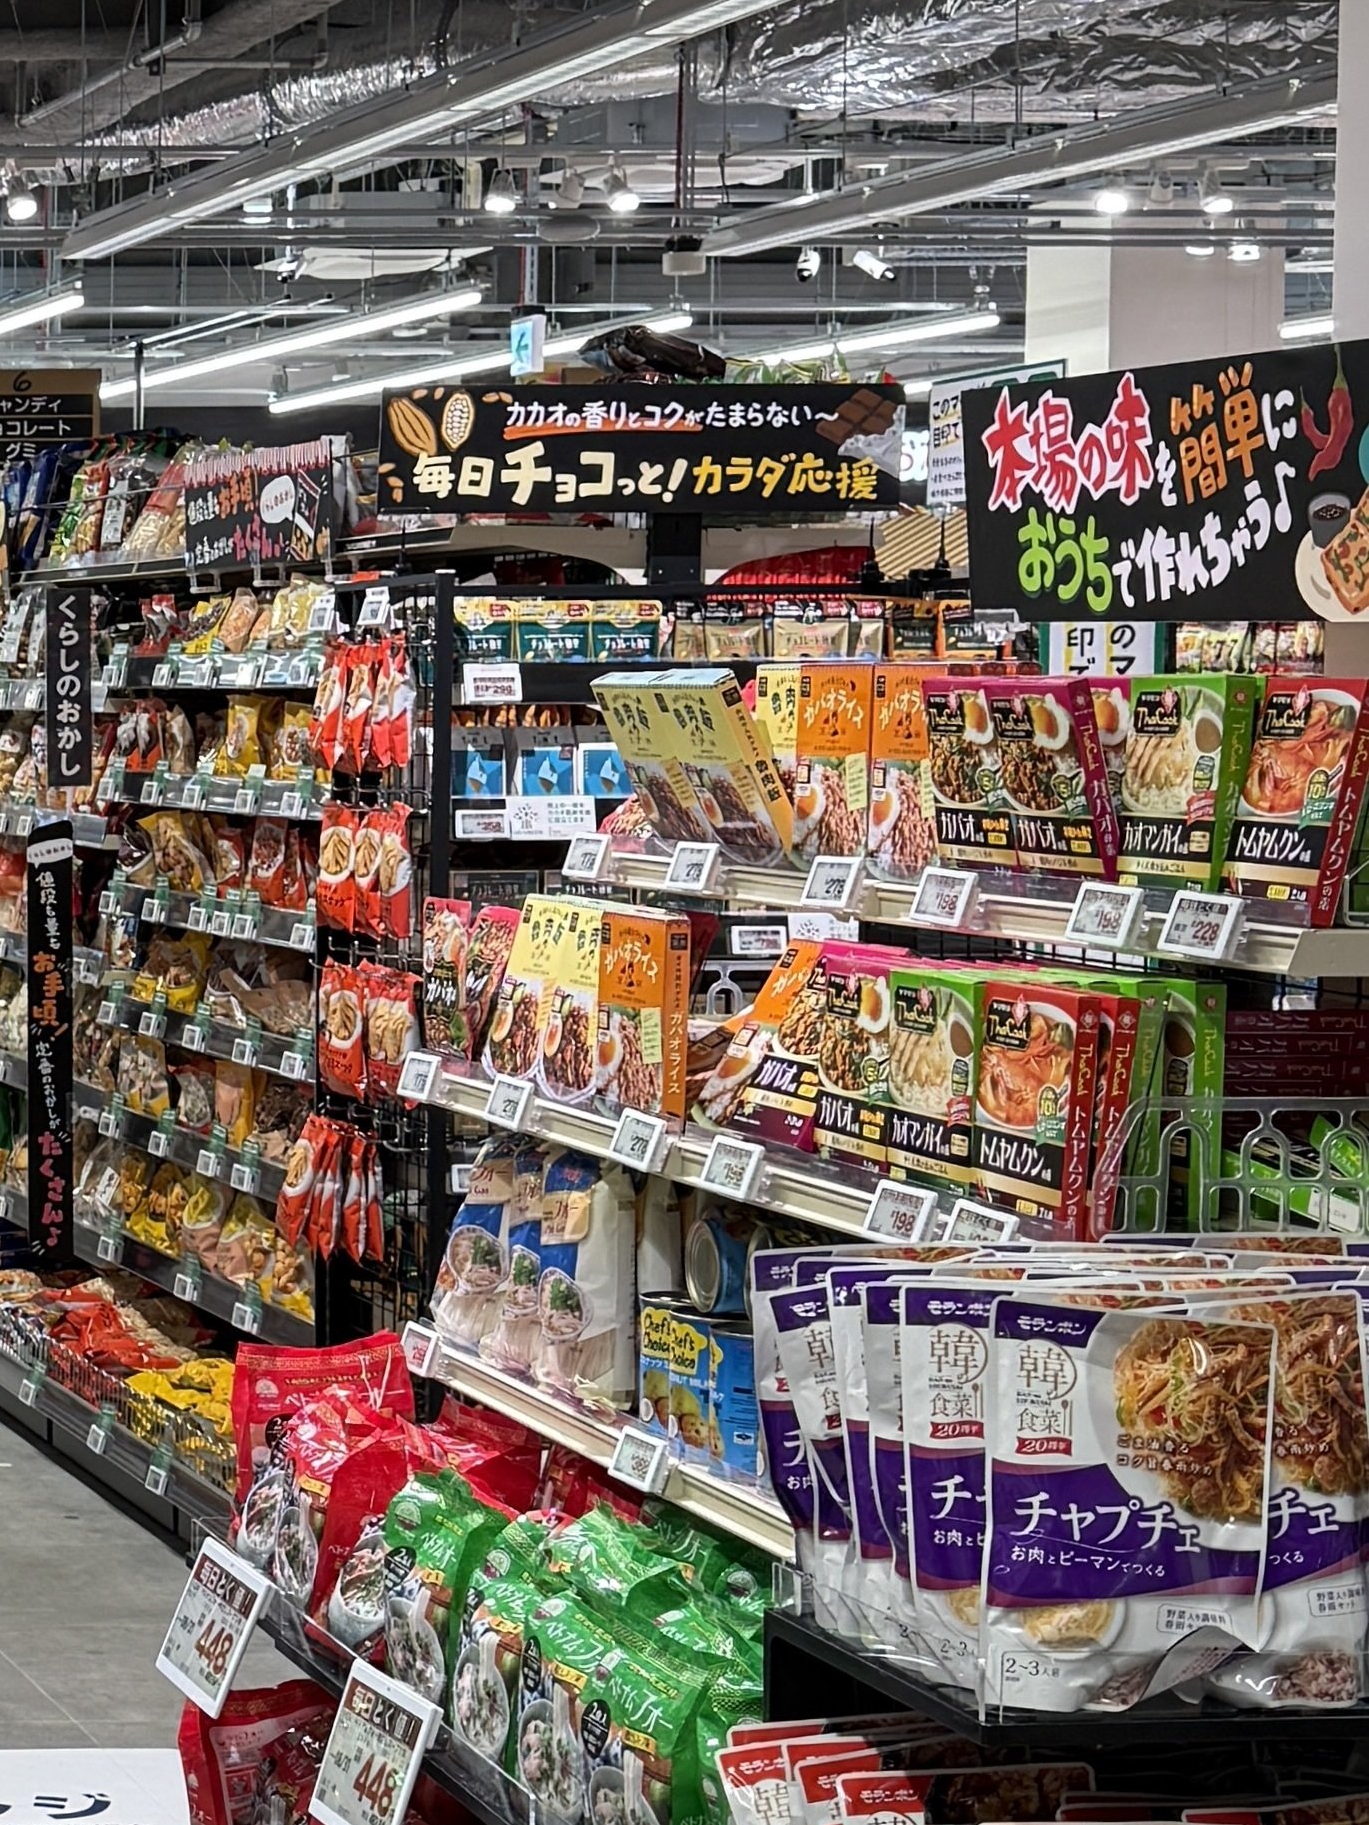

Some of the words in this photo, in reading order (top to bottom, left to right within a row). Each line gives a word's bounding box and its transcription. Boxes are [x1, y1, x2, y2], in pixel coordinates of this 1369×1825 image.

[13, 371, 32, 393] 6
[6, 442, 37, 459] グミ
[981, 362, 1297, 514] 本場の味を簡単に
[412, 440, 879, 506] 毎日チョコっと!カラダ応援
[54, 595, 83, 778] くらしのおかし
[668, 1013, 682, 1095] ガパオライス
[1016, 1315, 1088, 1336] モランボン
[928, 1328, 983, 1386] 韓
[1019, 1343, 1065, 1398] 韓
[930, 1391, 977, 1420] 食菜
[1015, 1406, 1062, 1435] 食菜
[1021, 1439, 1068, 1454] 20周年
[1117, 1435, 1191, 1456] ごま油香る
[1010, 1490, 1203, 1555] チャプチェ
[1011, 1545, 1166, 1578] お肉とピーマンでつくる
[1269, 1551, 1305, 1566] つくる
[195, 1619, 234, 1677] 448
[353, 1754, 397, 1819] 448
[859, 1789, 919, 1804] モランボン
